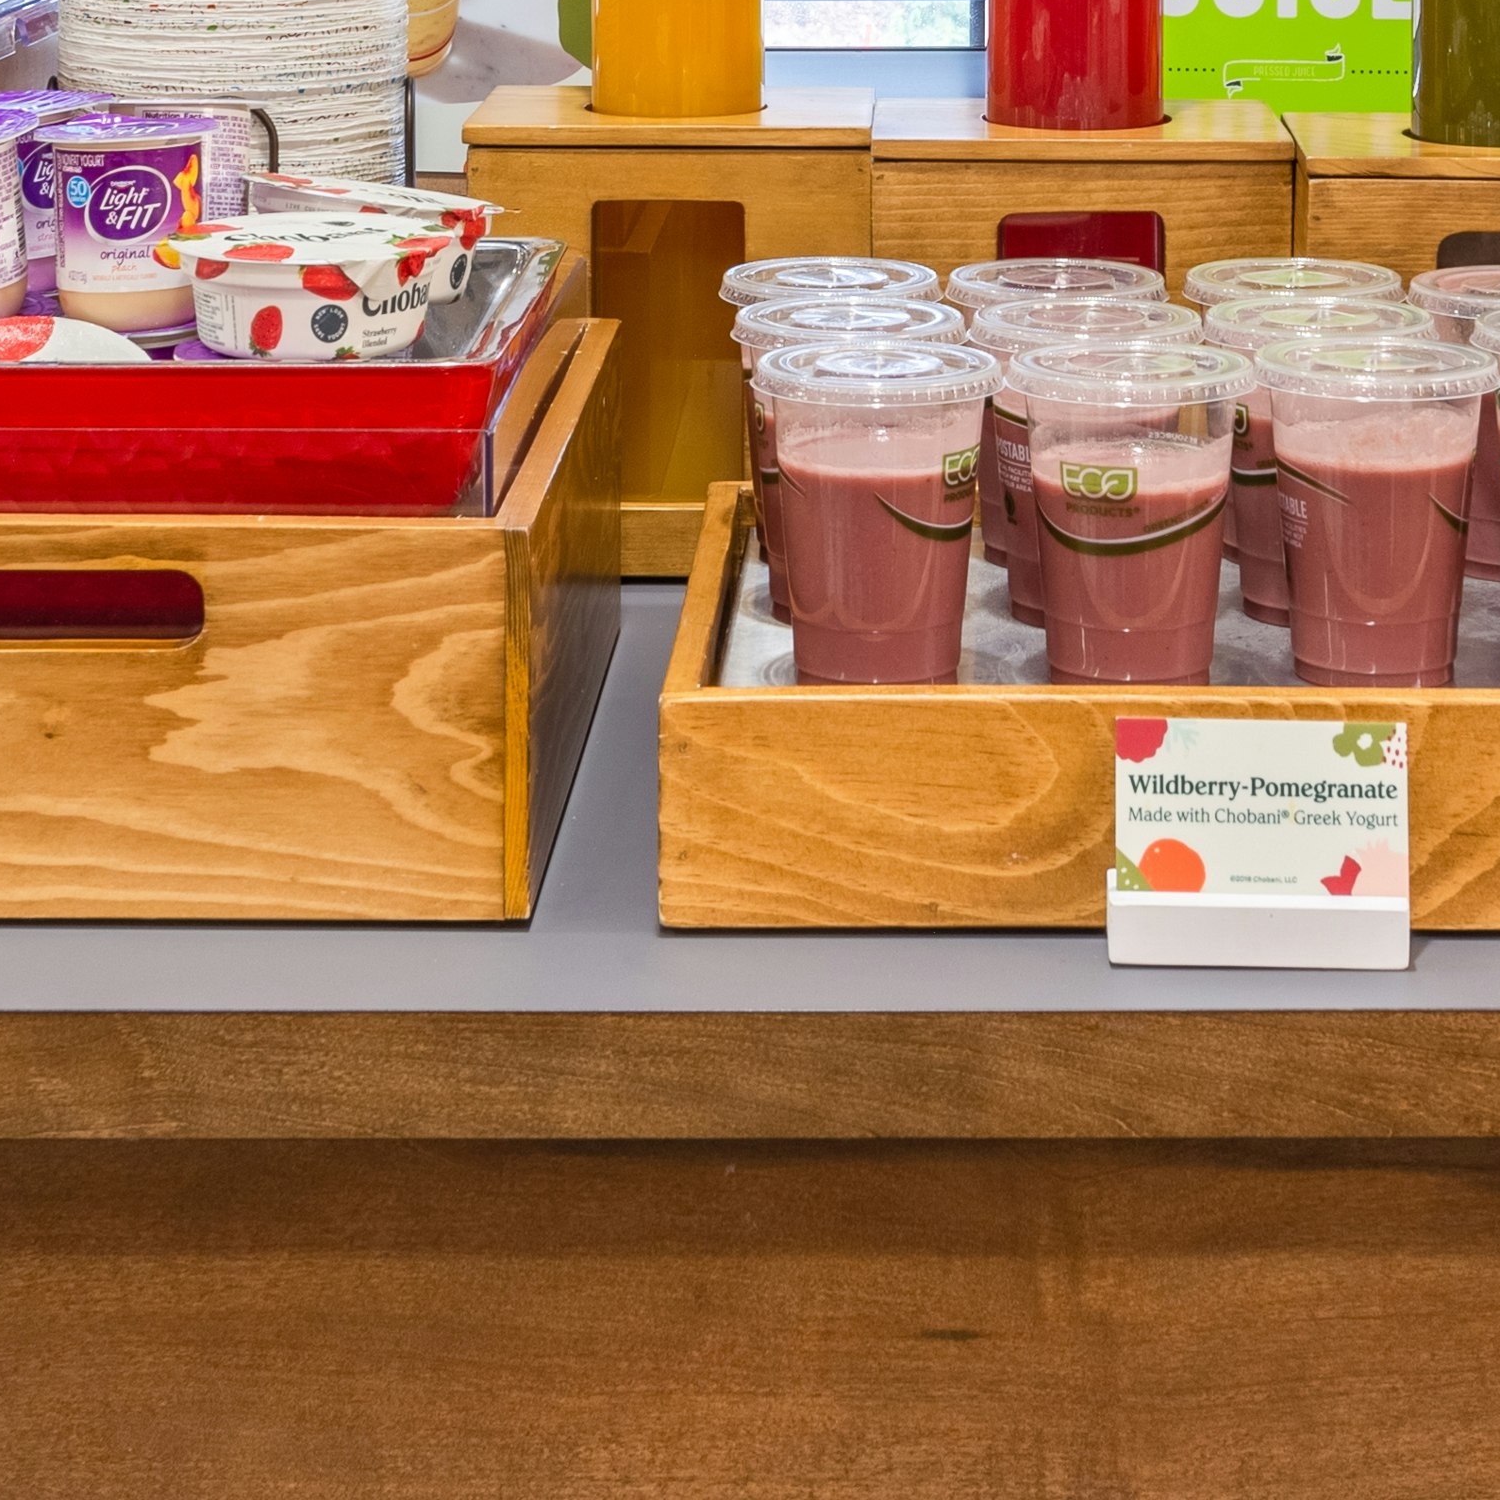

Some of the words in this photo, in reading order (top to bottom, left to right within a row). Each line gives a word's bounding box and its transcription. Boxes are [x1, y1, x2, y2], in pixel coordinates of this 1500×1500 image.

[70, 181, 88, 196] 50
[100, 186, 148, 211] Light
[100, 244, 151, 266] original
[362, 327, 397, 338] Strawberry
[1062, 463, 1134, 500] ECO
[1128, 773, 1398, 802] Wildberry-Pomegranate
[1128, 806, 1172, 823] Made
[1177, 807, 1211, 823] with
[1294, 809, 1342, 826] Greek
[1347, 810, 1398, 830] Yogurt
